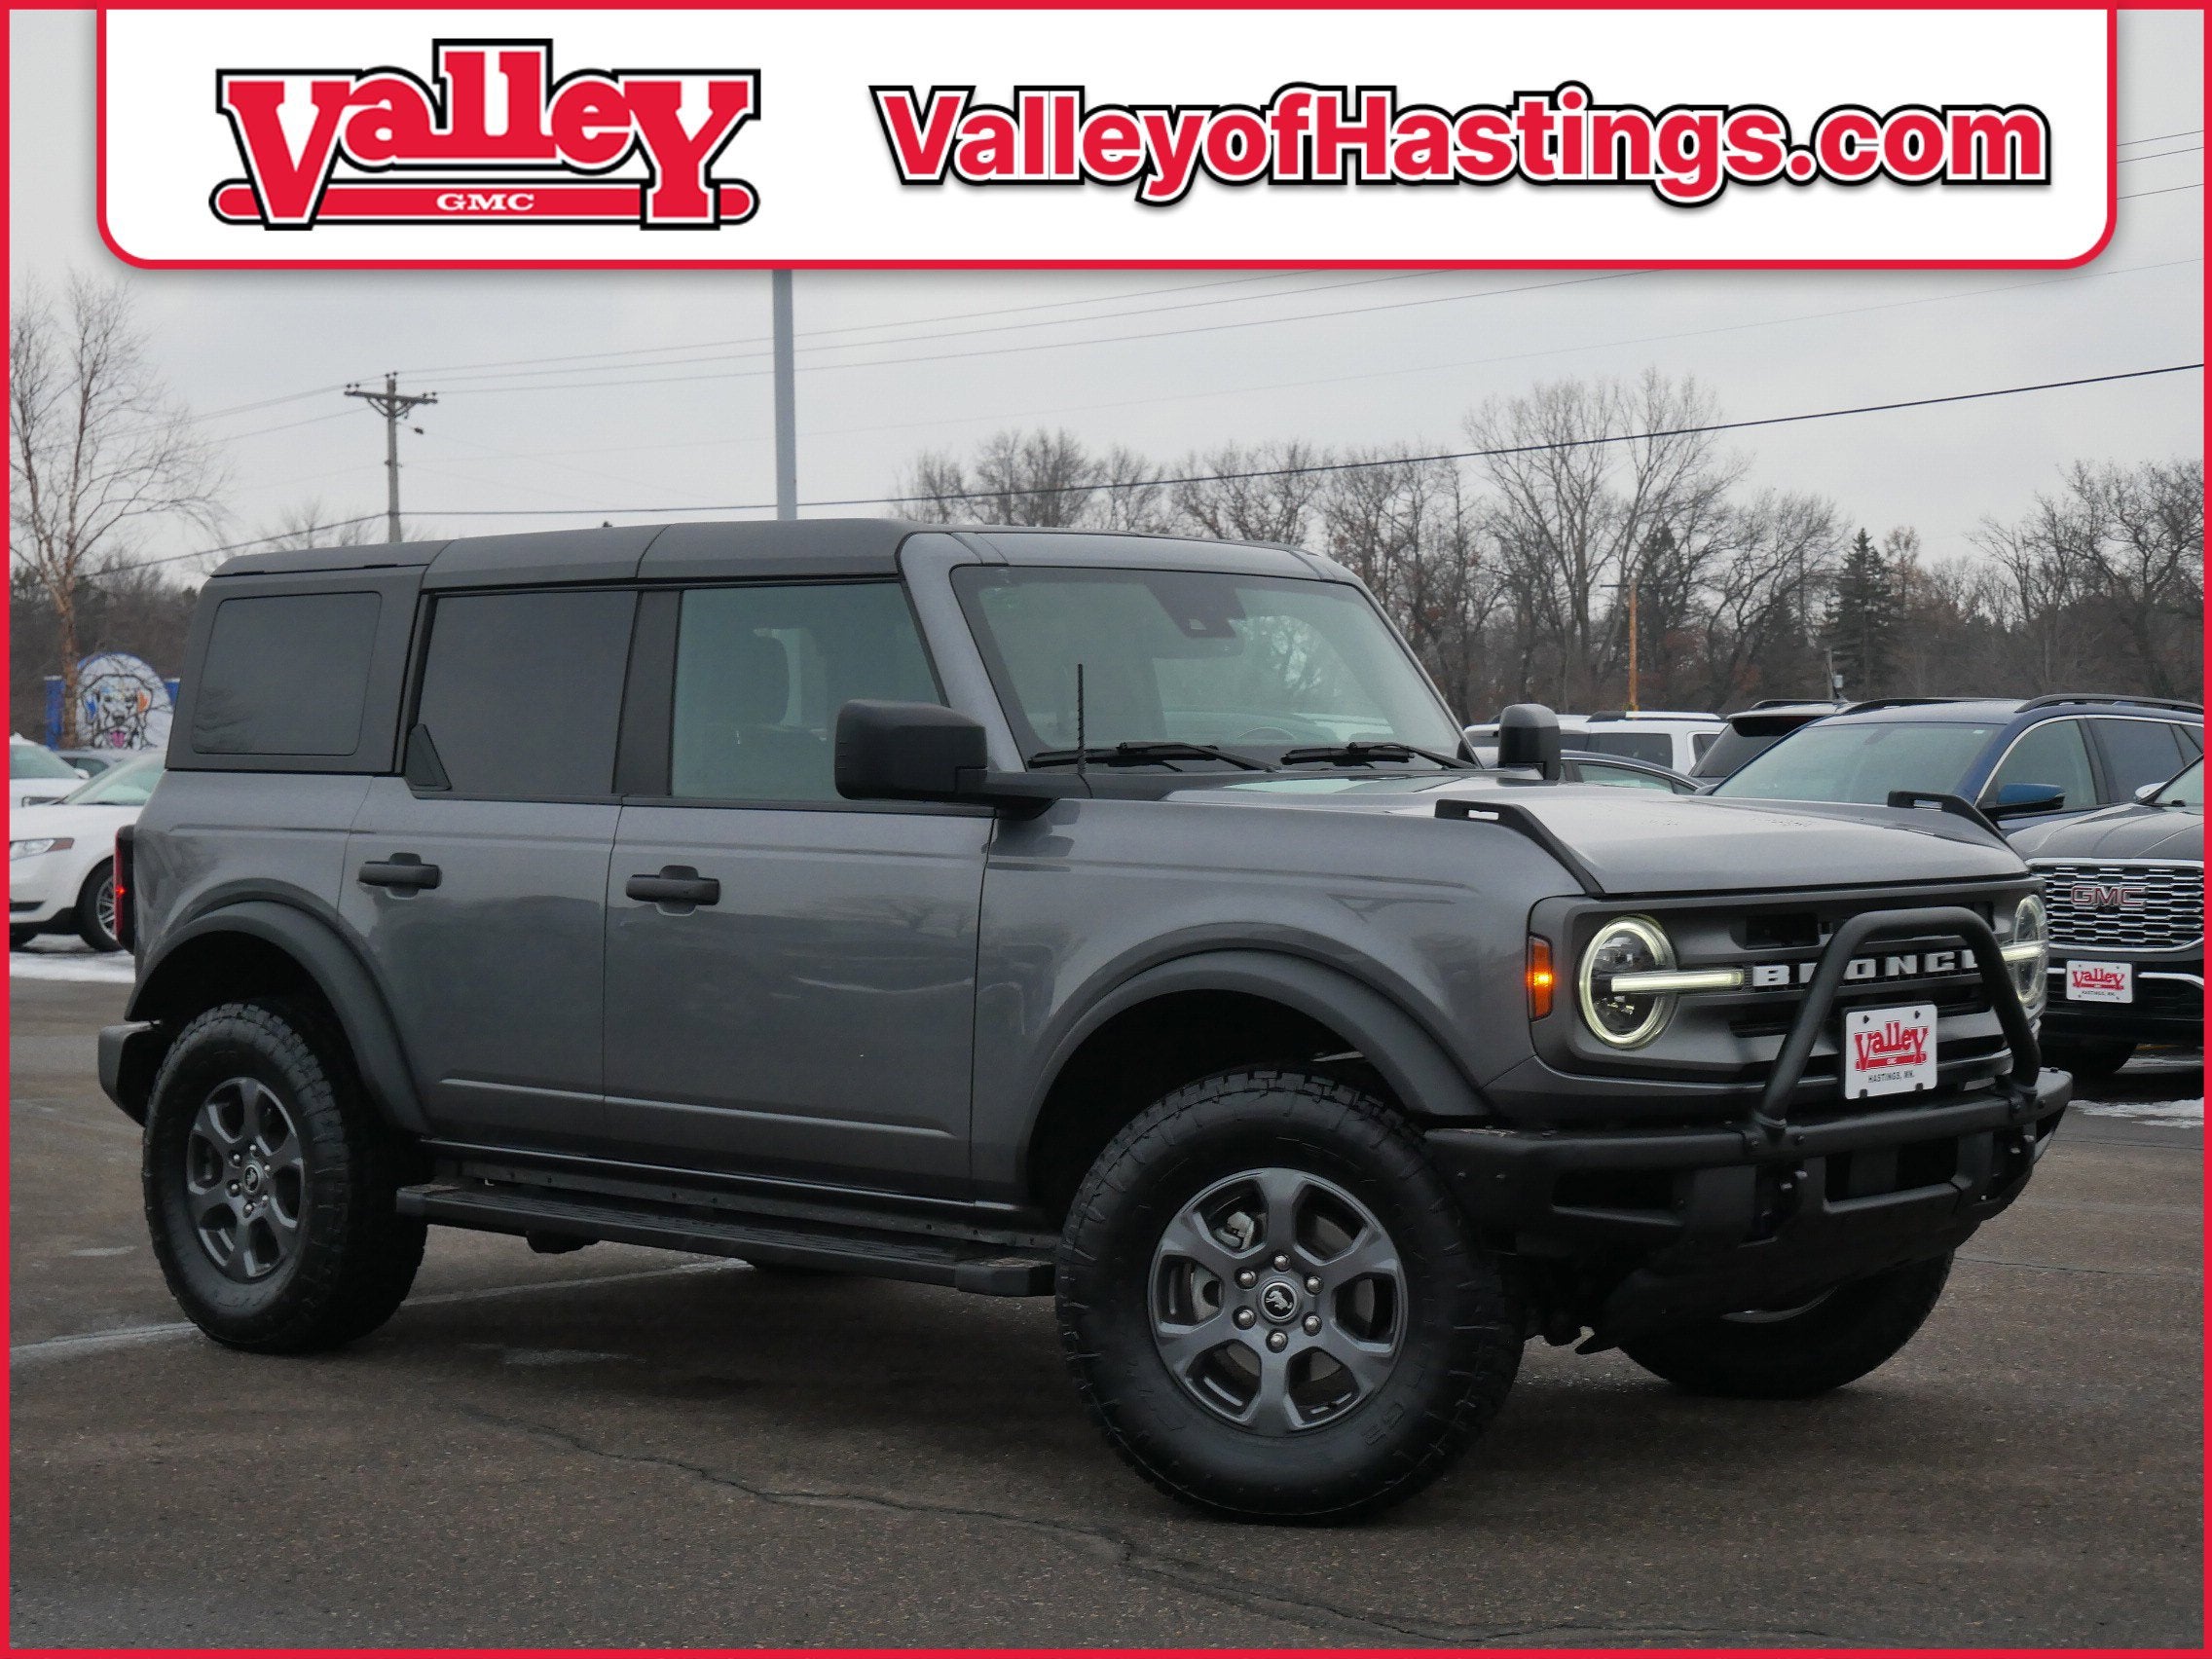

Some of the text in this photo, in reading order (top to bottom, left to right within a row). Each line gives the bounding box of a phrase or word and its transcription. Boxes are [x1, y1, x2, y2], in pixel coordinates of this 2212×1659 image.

[2071, 885, 2144, 905] GMC
[2072, 968, 2125, 990] Valley
[1855, 1020, 1929, 1071] Valley
